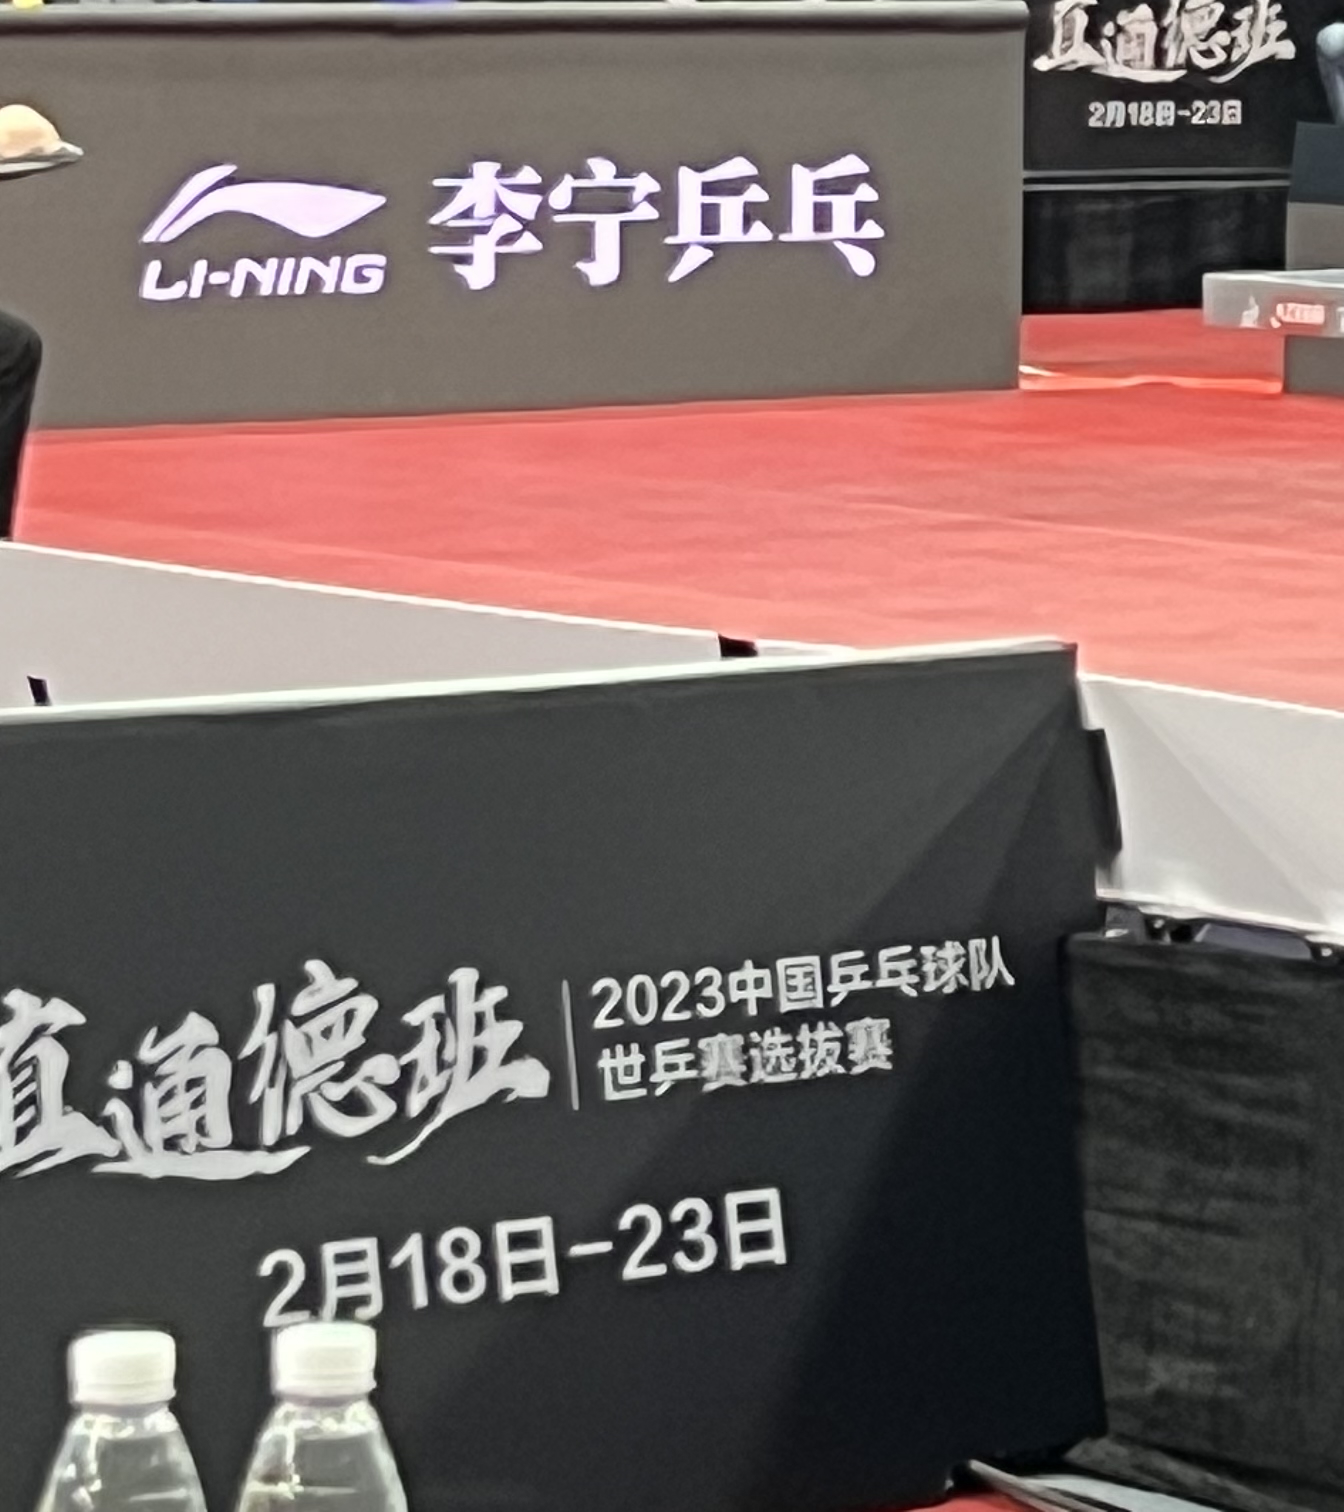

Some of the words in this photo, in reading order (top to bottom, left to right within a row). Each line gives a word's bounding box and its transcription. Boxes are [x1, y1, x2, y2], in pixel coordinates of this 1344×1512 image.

[1087, 99, 1243, 128] 2月18日-23日
[140, 253, 387, 301] LI-NING
[428, 153, 886, 290] 李宁乒乓
[591, 934, 1016, 1030] 2023中国乒乓球队
[0, 958, 551, 1181] 直通德班
[597, 1016, 893, 1101] 世乒赛选拔赛
[257, 1187, 788, 1328] 2月18日-23日
